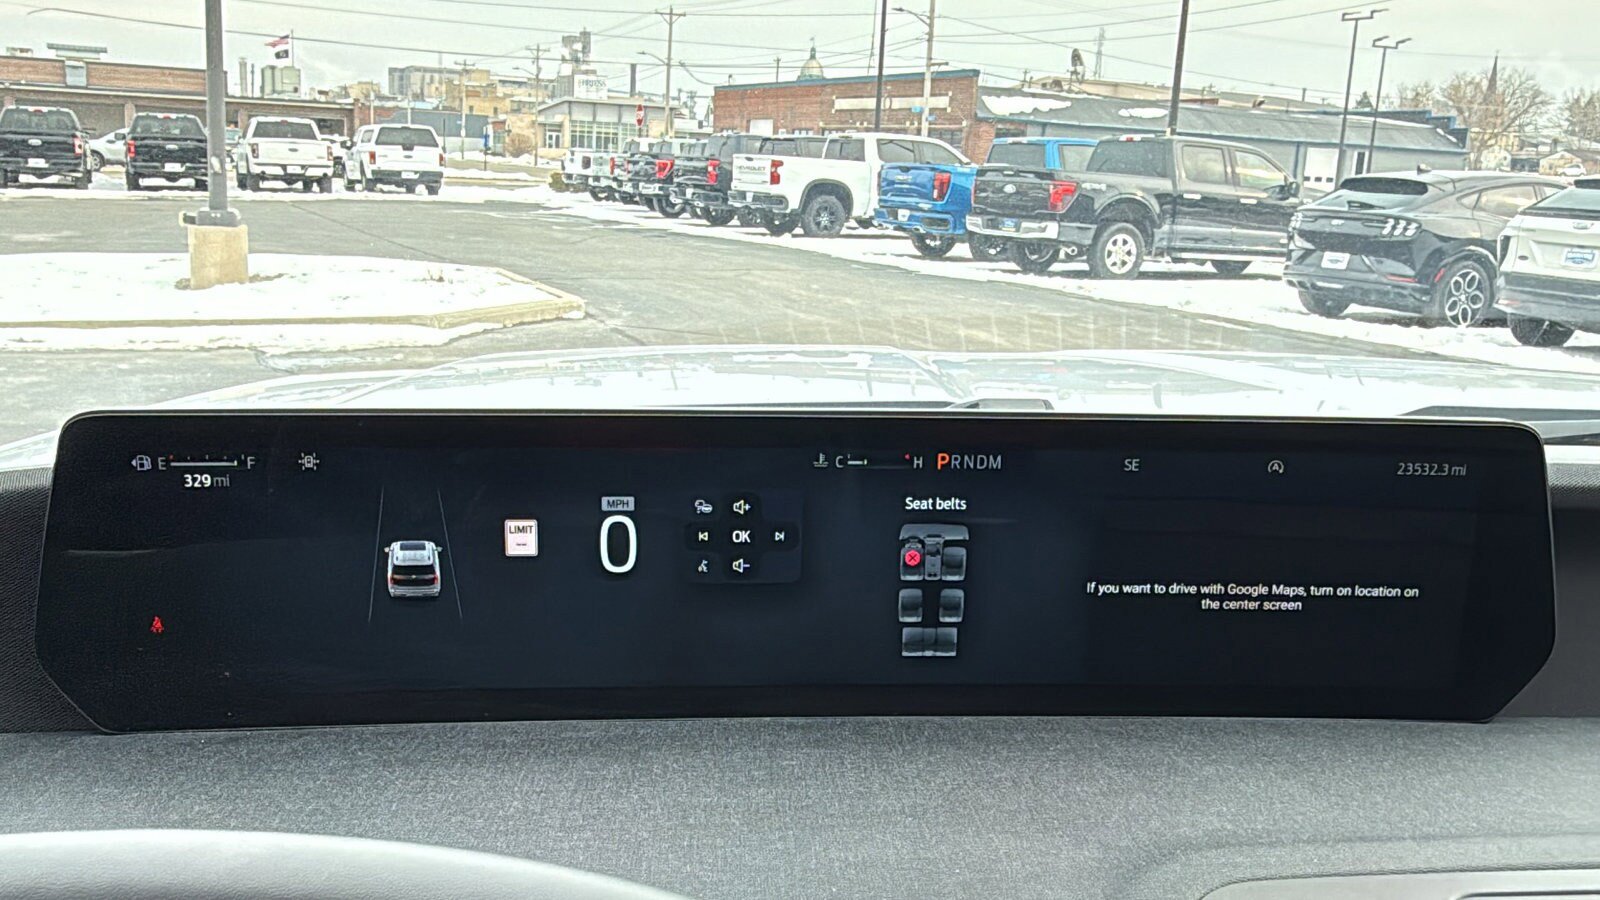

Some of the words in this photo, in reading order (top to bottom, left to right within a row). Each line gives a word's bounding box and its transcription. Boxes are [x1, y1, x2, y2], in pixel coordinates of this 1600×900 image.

[157, 457, 166, 470] E
[247, 456, 255, 469] F
[835, 456, 844, 468] C
[913, 456, 923, 469] H
[1124, 458, 1140, 472] SE
[1397, 462, 1449, 476] 23532.3
[1451, 463, 1467, 476] mi
[183, 473, 212, 488] 329
[213, 474, 230, 487] mi
[606, 499, 629, 509] MPH
[904, 496, 934, 511] Seat
[936, 496, 967, 511] belts
[508, 525, 534, 535] LIMIT
[732, 530, 751, 543] OK
[599, 514, 638, 574] 0
[1086, 582, 1096, 594] If
[1098, 585, 1120, 597] you
[1122, 584, 1151, 595] want
[1154, 584, 1167, 595] to
[1169, 583, 1198, 595] drive
[1200, 583, 1225, 595] with
[1227, 584, 1269, 598] Google
[1271, 585, 1307, 598] Maps,
[1310, 586, 1334, 597] turn
[1336, 588, 1353, 598] on
[1355, 585, 1402, 598] location
[1404, 589, 1420, 598] on
[1200, 599, 1221, 611] the
[1222, 600, 1261, 611] center
[1263, 601, 1303, 612] screen
